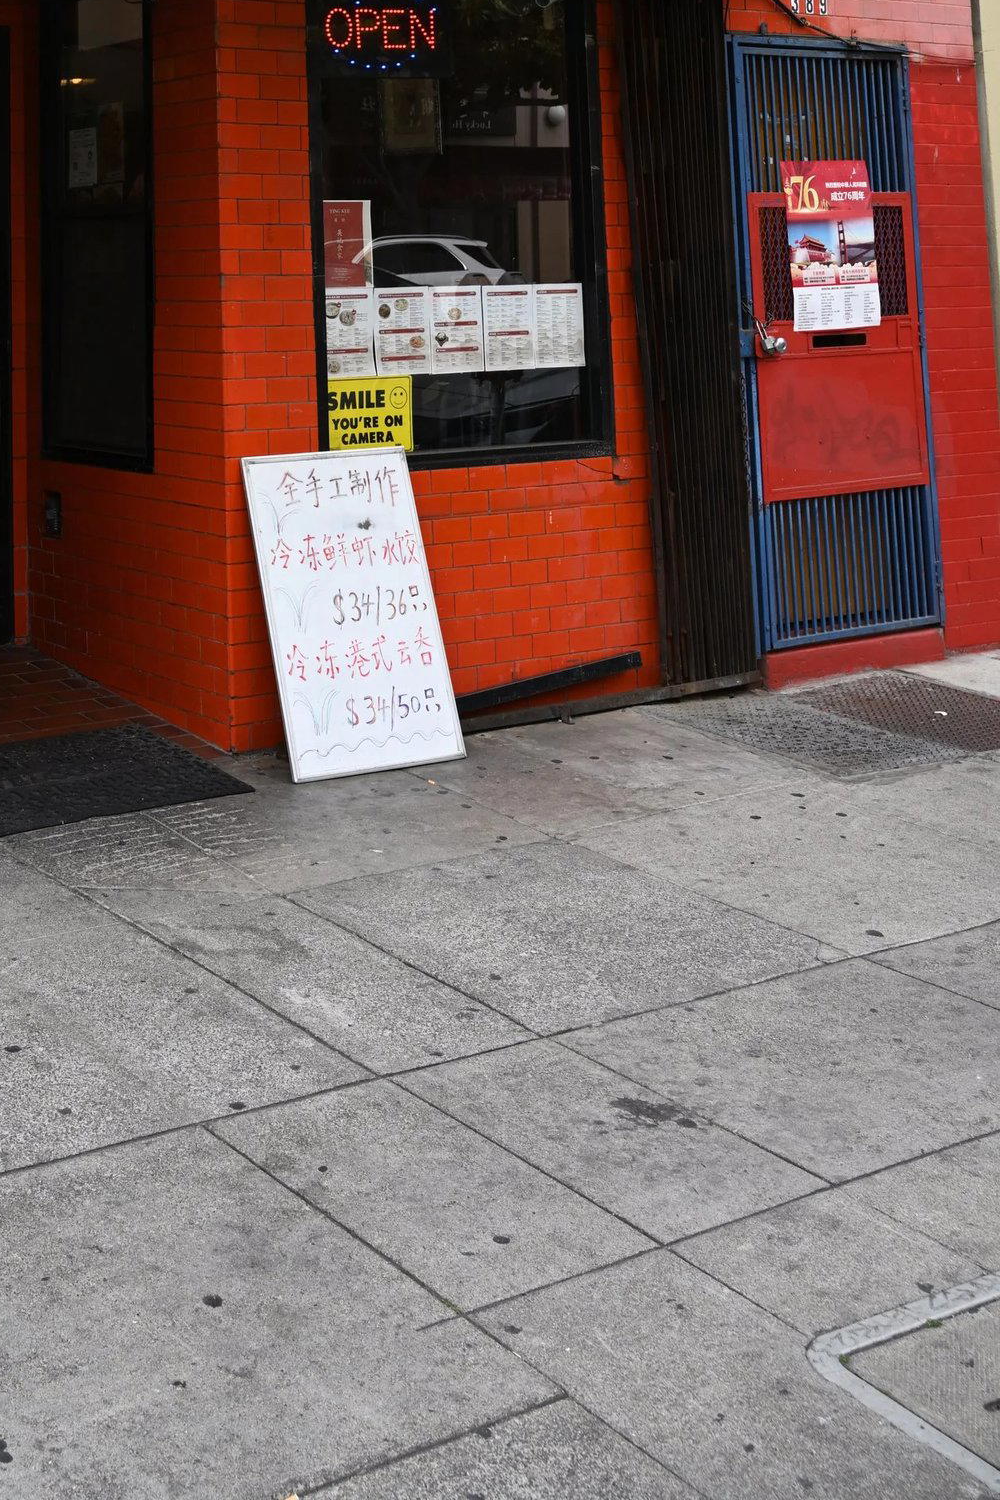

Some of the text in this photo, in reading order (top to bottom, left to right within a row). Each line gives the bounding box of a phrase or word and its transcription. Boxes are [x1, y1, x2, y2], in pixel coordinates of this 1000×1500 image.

[325, 7, 436, 49] OPEN
[790, 175, 819, 212] 76
[328, 389, 386, 411] SMILE
[332, 415, 403, 431] YOU'RE ON
[341, 430, 395, 445] CAMERA
[276, 466, 400, 508] 全手工制作
[270, 529, 420, 571] 冷冻鲜虾水饺
[286, 626, 434, 681] 冷冻港式云吞
